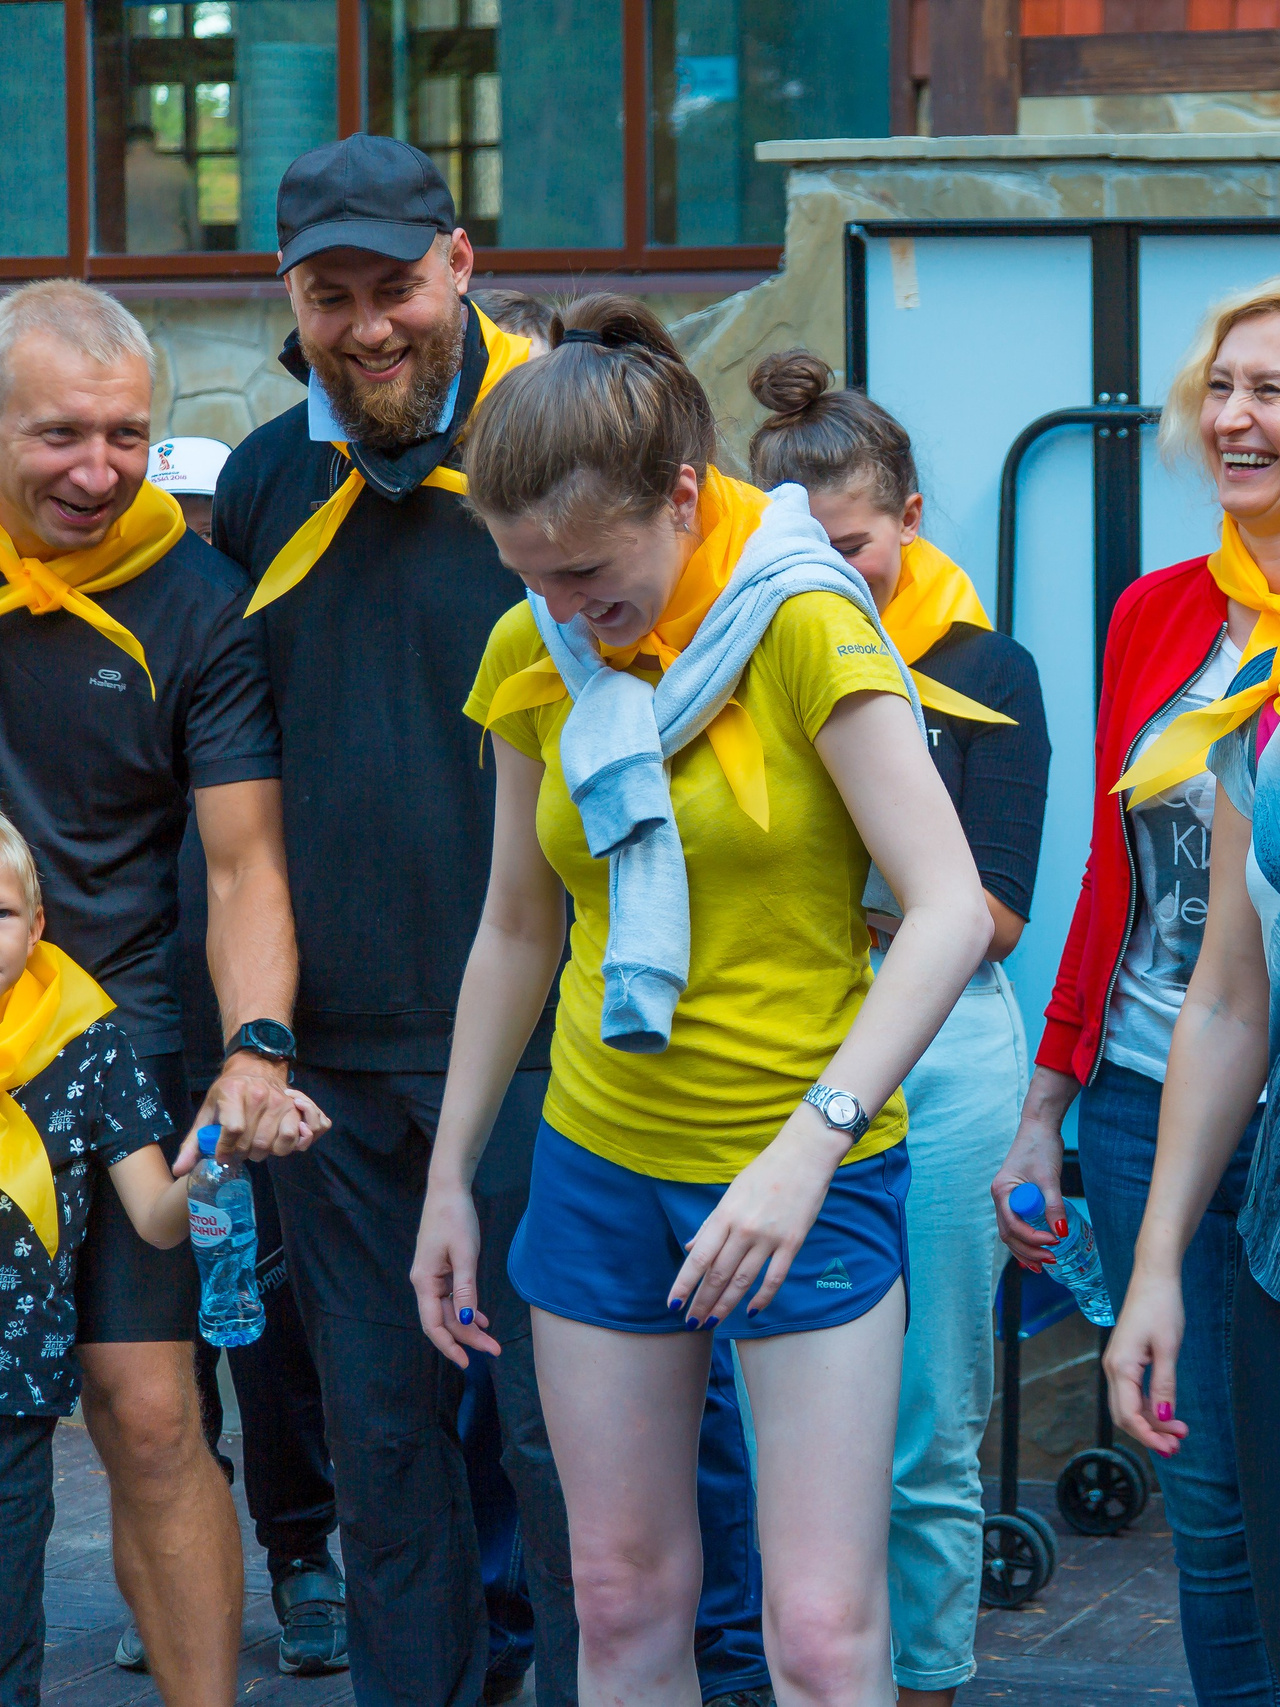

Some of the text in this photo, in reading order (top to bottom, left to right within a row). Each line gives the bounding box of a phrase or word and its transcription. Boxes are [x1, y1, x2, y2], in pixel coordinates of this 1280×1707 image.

[837, 643, 879, 657] Reebok
[1157, 880, 1209, 925] Je
[816, 1280, 853, 1290] Reebok
